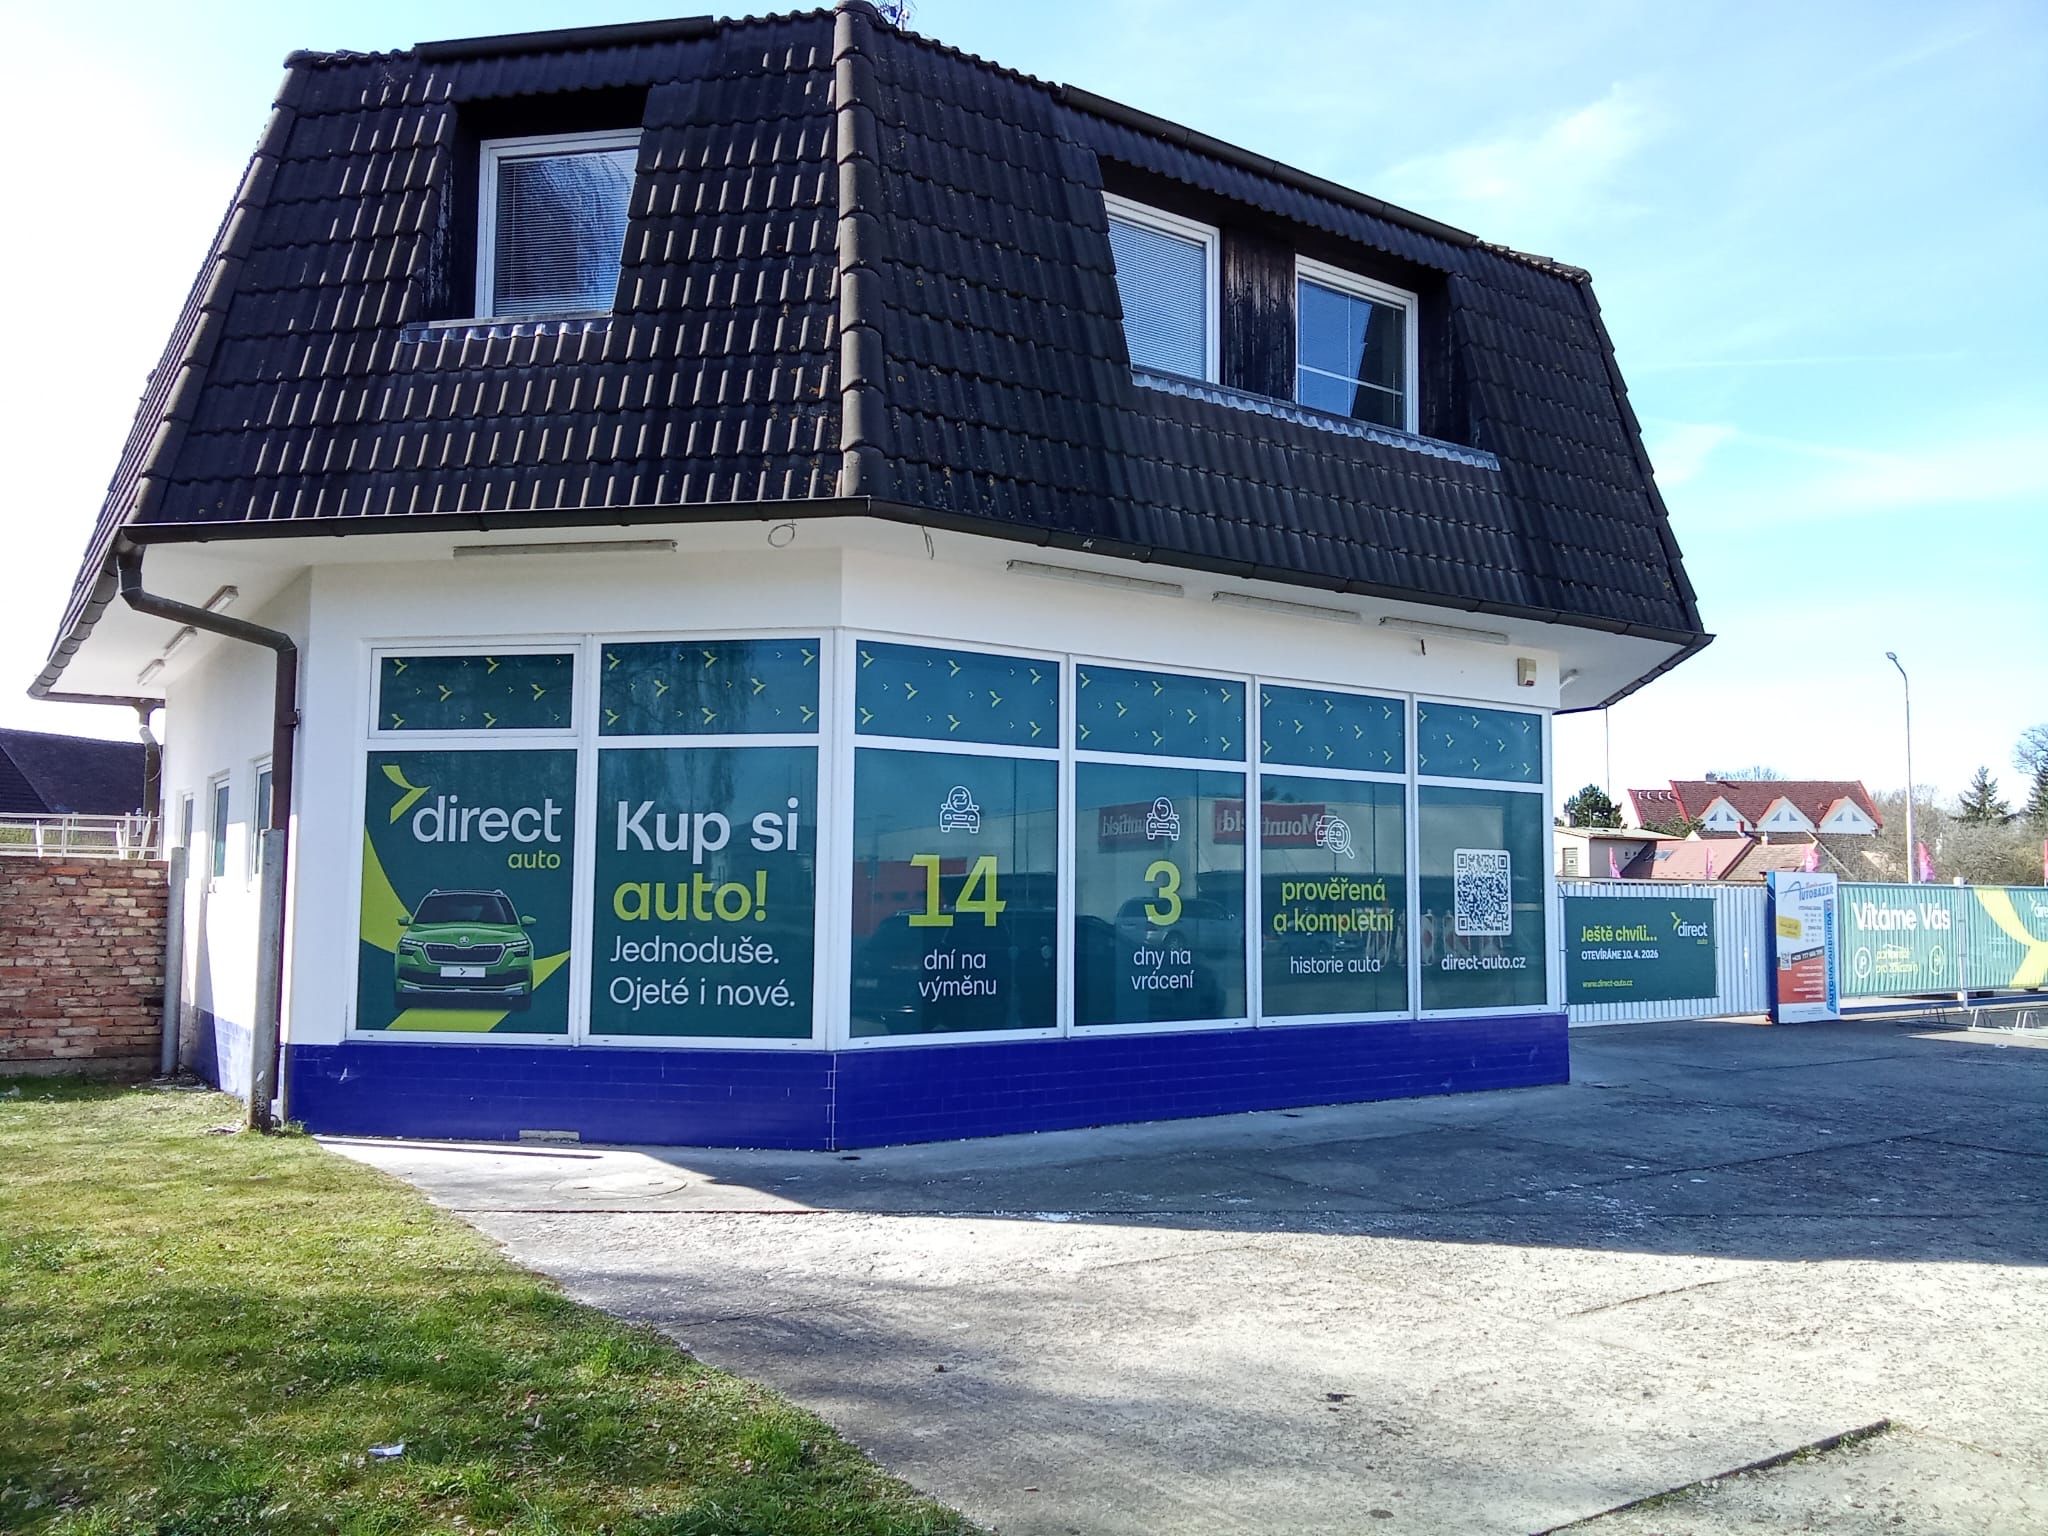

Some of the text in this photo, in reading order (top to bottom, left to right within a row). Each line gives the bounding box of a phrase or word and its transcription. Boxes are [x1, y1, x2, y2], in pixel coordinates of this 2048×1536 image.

[412, 795, 562, 843] direct
[616, 797, 798, 865] Kup si
[507, 850, 561, 870] auto
[613, 870, 767, 922] auto!
[908, 854, 1007, 927] 14
[1144, 860, 1183, 926] 3
[1281, 878, 1387, 905] prověřená
[1273, 909, 1395, 937] a kompletní
[1677, 922, 1708, 937] direct
[1919, 902, 1951, 930] Vás
[1581, 925, 1613, 942] Ještě
[610, 935, 780, 964] Jednoduše.
[924, 948, 987, 970] dní na
[1133, 947, 1192, 968] dny na
[1441, 954, 1526, 971] direct-auto.cz
[1581, 948, 1621, 960] OTEVÍRÁME
[1622, 949, 1633, 959] 10.
[1634, 949, 1641, 959] 4.
[1290, 956, 1381, 974] historie auta
[609, 976, 796, 1010] Ojeté i nové.
[918, 975, 997, 1002] výměnu
[1131, 970, 1194, 990] vrácení
